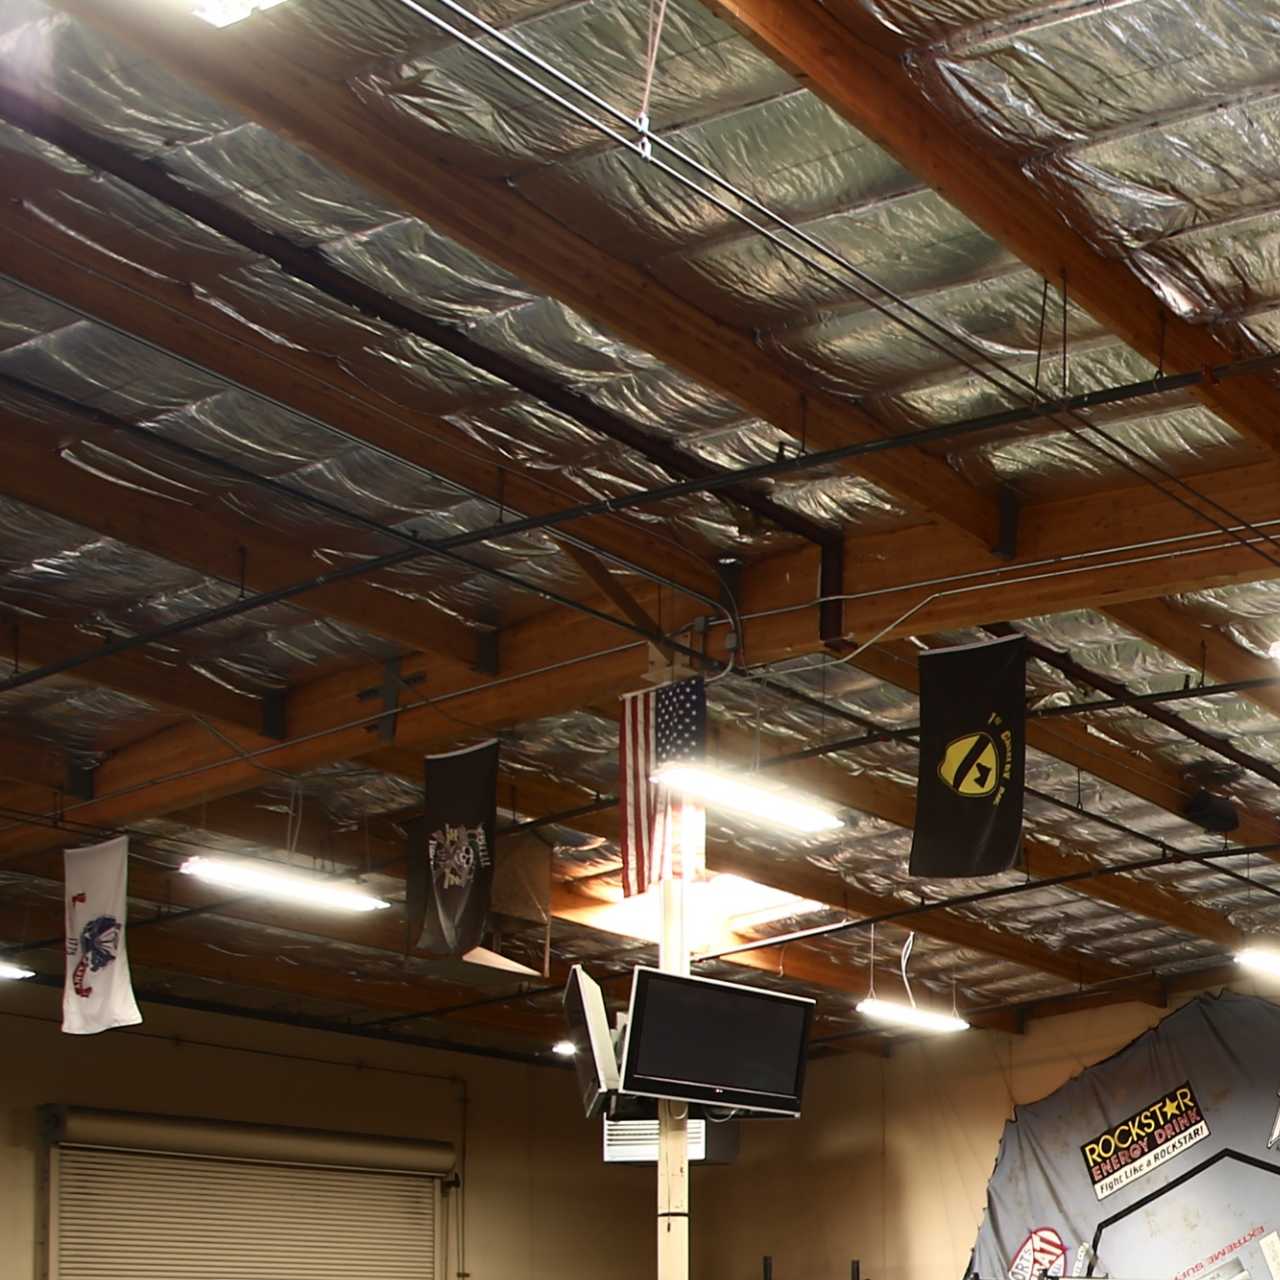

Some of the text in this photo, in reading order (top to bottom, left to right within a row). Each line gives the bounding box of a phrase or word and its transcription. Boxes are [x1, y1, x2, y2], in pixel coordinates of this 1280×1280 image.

[1091, 1107, 1200, 1181] ENERGY DRINK
[1100, 1175, 1122, 1194] Fight
[1153, 1125, 1204, 1163] ROCKSTAR!
[1207, 1225, 1265, 1266] EXTREME
